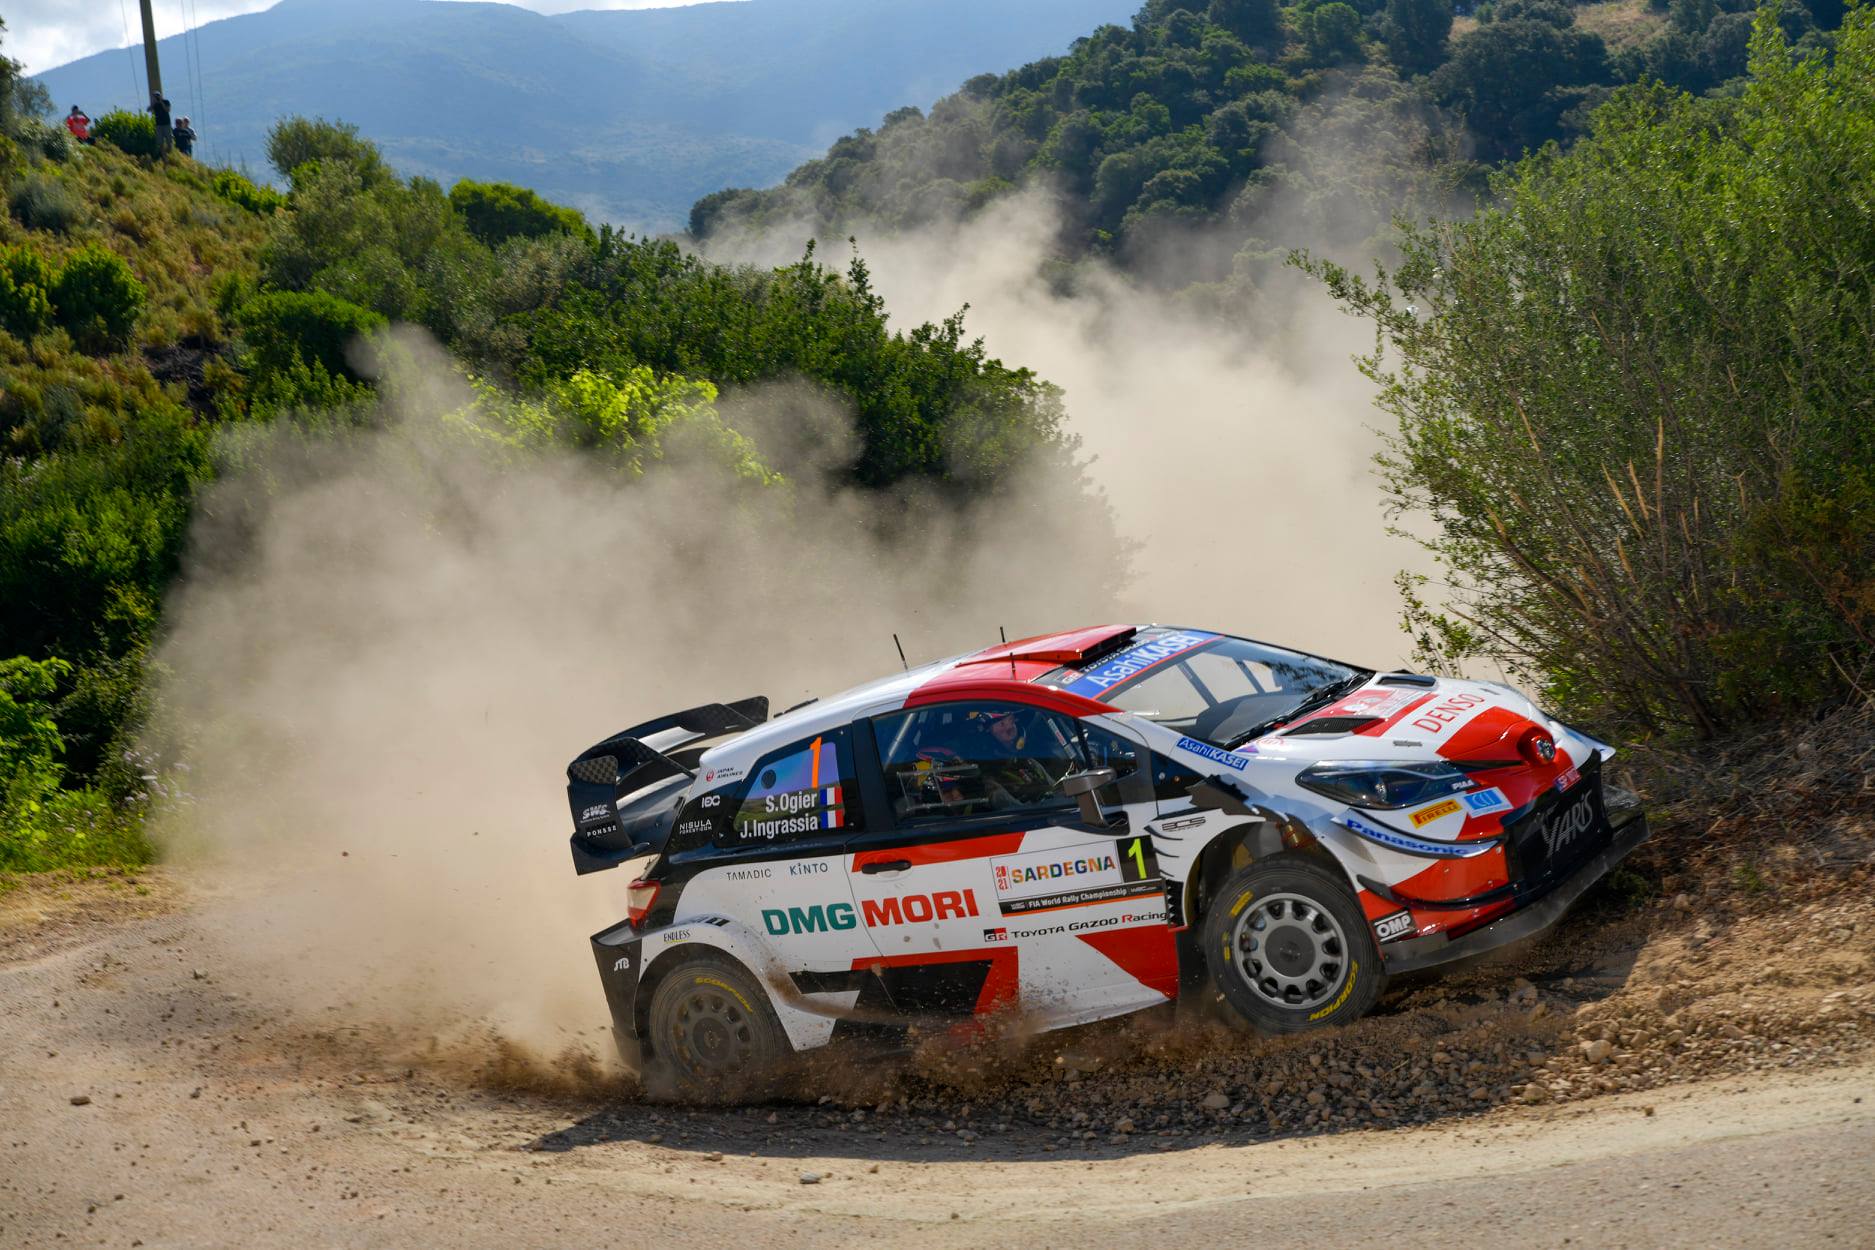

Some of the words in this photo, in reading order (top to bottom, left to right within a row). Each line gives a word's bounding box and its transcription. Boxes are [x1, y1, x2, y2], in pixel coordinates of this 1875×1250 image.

[1086, 634, 1205, 688] AsahiKASEI
[1412, 693, 1485, 733] DENSO
[809, 736, 822, 789] 1
[1179, 739, 1247, 770] AsahiKASEI
[1451, 779, 1475, 790] PIAA
[765, 791, 818, 814] S.Ogier
[1414, 800, 1460, 825] PIRELLI
[586, 825, 617, 837] PONSSE
[680, 819, 712, 831] NISULA
[740, 813, 819, 839] J.Ingrassia
[1347, 819, 1467, 855] Panasonic
[1011, 855, 1116, 884] SARDEGNA
[1128, 838, 1147, 880] 1
[726, 868, 772, 881] TAMADIC
[1029, 900, 1041, 908] FIA
[1041, 897, 1062, 906] World
[1062, 894, 1080, 904] Rally
[1080, 887, 1128, 900] Championship
[761, 903, 857, 936] DMG
[861, 888, 979, 927] MORI
[1011, 925, 1065, 939] TOYOTA
[1069, 917, 1118, 931] GAZOO
[1121, 911, 1168, 924] Racing
[663, 929, 691, 942] ENDLESS
[1375, 914, 1412, 938] OMP
[1308, 959, 1359, 1022] SCORPION
